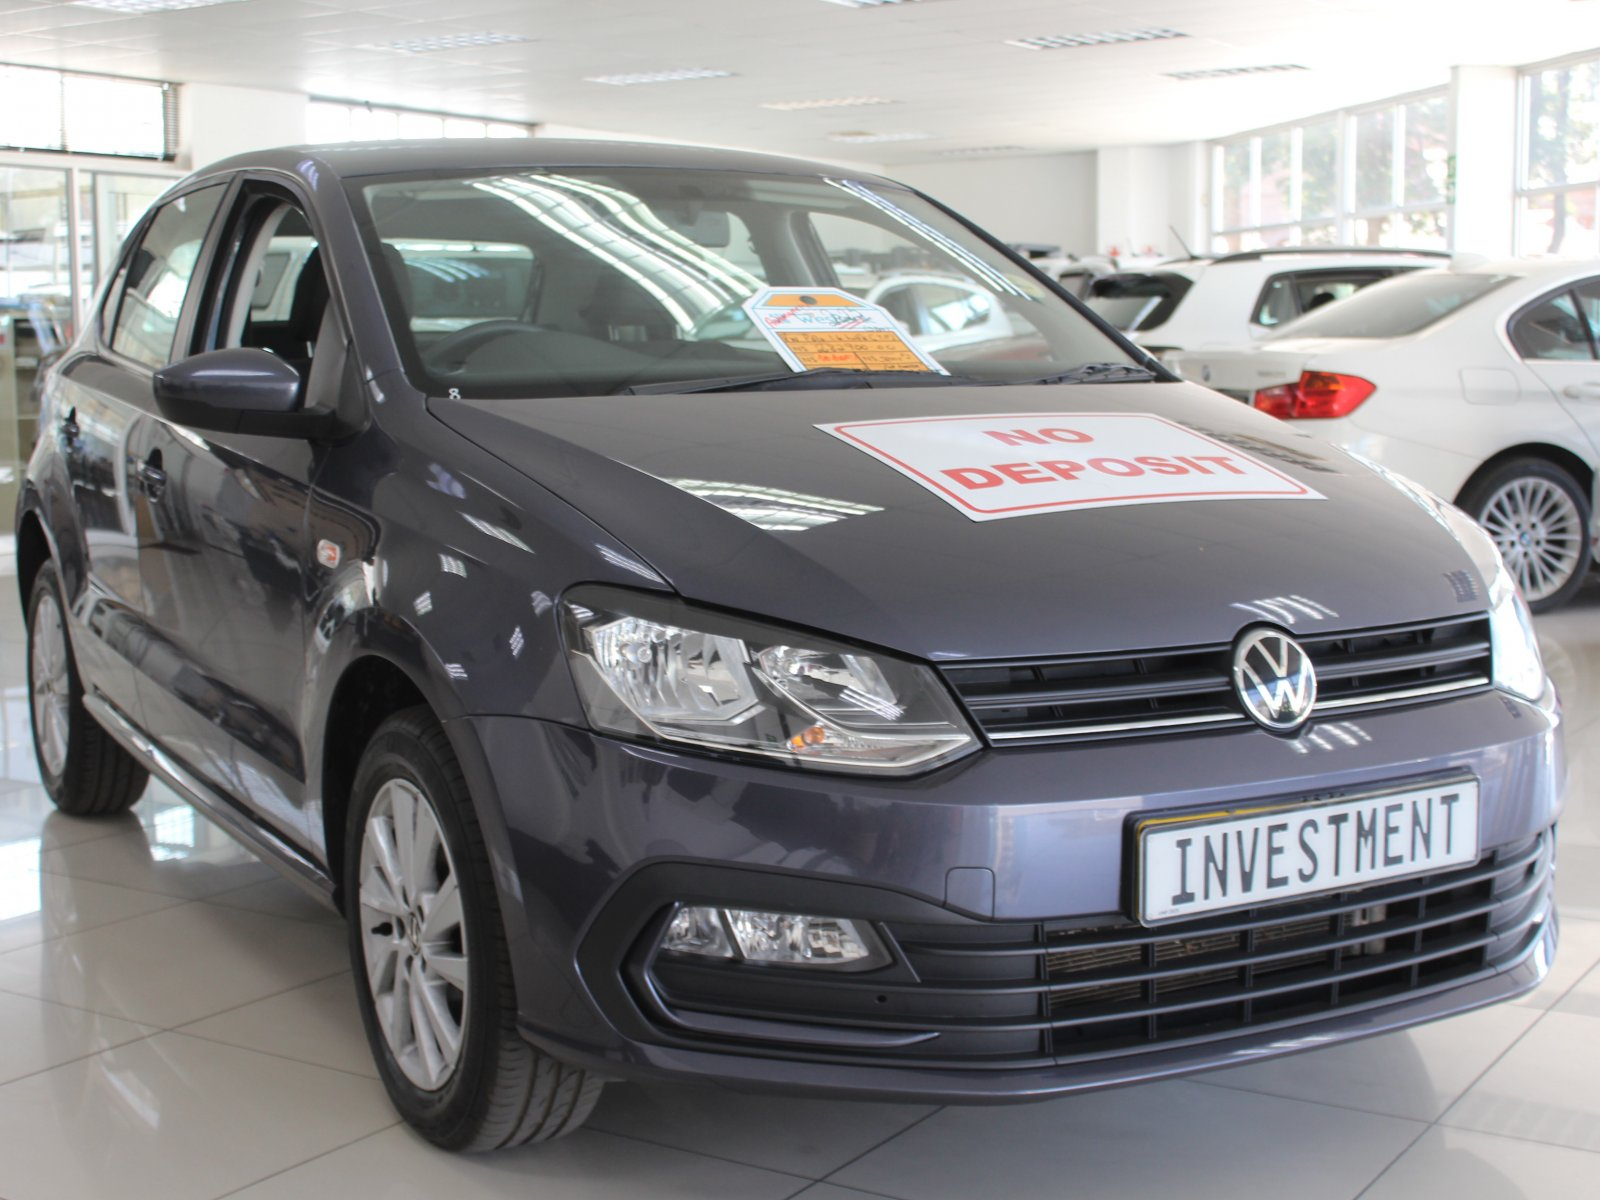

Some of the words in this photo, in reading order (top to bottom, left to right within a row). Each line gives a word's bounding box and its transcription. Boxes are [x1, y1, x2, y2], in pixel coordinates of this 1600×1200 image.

[985, 427, 1094, 447] NO
[939, 455, 1248, 491] DEPOSIT
[1171, 793, 1460, 907] INVESTMENT
